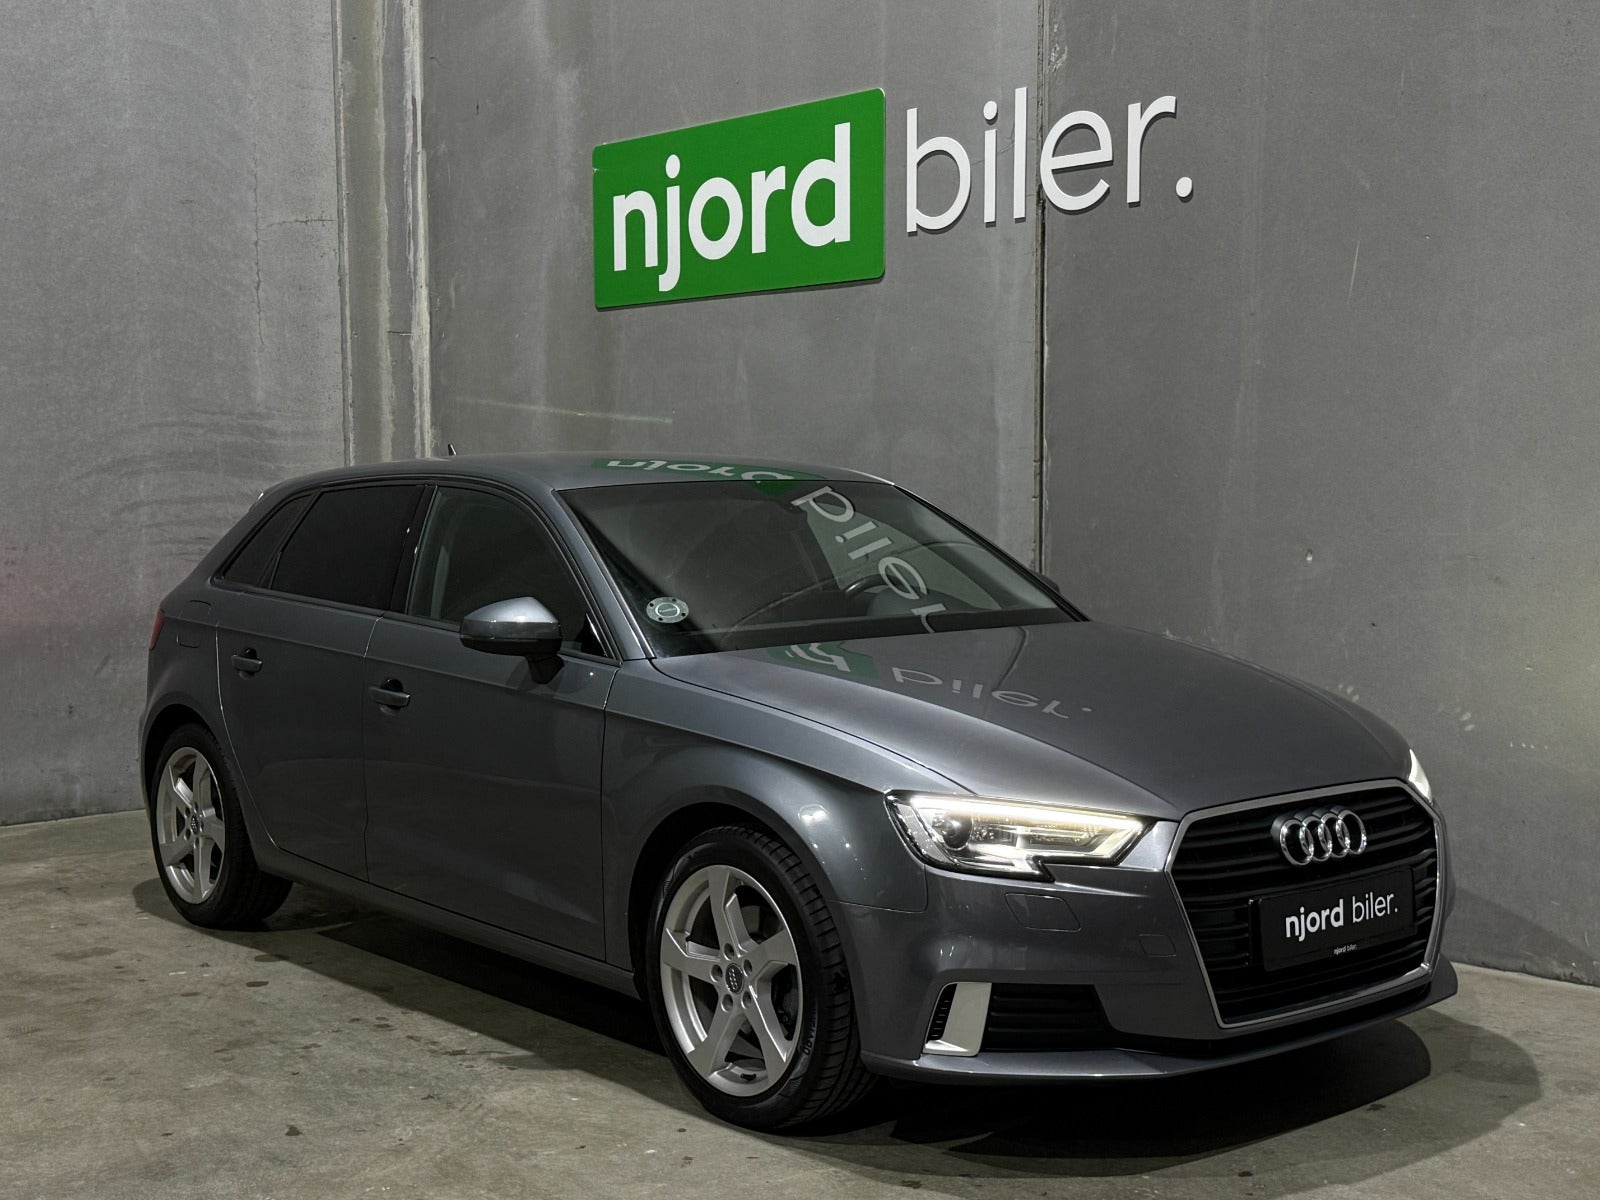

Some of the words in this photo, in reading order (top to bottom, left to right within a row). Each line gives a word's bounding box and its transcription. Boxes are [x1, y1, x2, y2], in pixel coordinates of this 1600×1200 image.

[612, 123, 851, 292] njord
[906, 87, 1193, 235] biler.
[1285, 899, 1344, 942] njord
[1352, 892, 1398, 923] biler.
